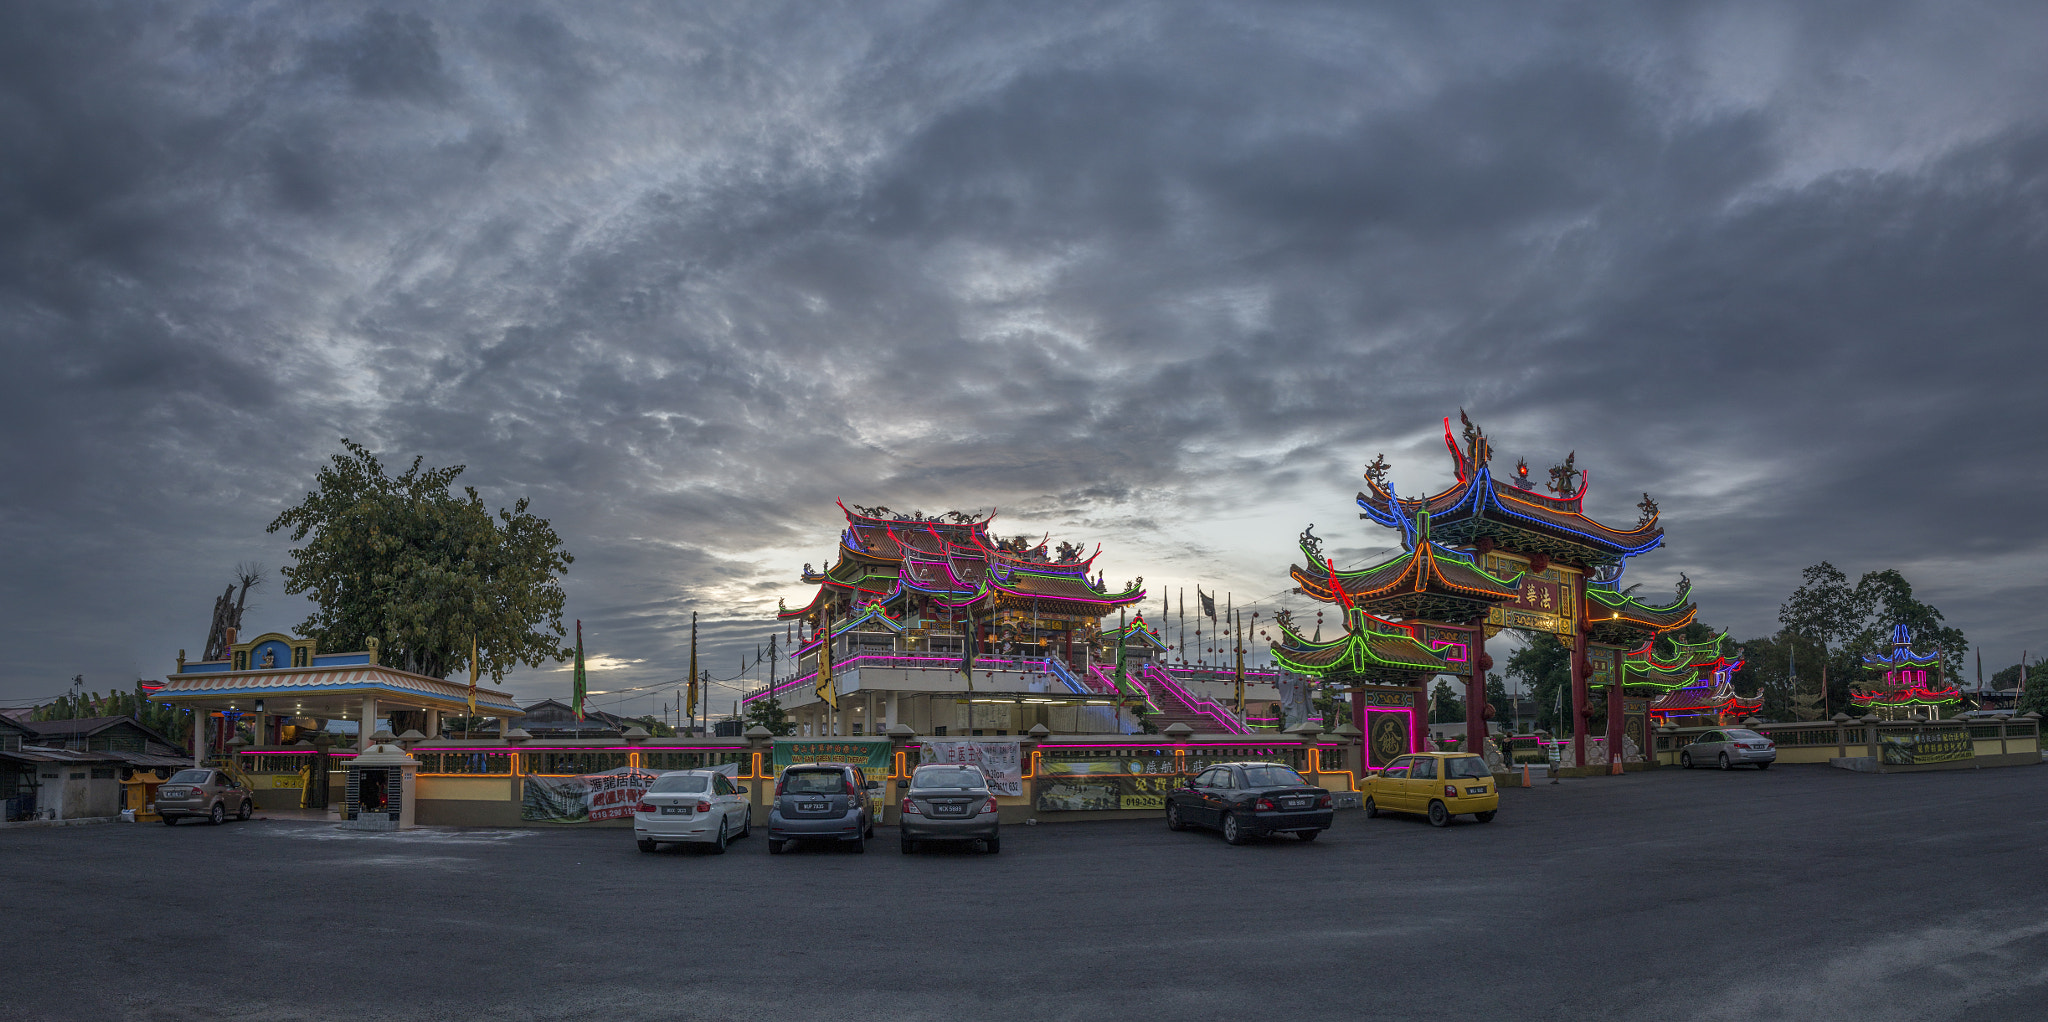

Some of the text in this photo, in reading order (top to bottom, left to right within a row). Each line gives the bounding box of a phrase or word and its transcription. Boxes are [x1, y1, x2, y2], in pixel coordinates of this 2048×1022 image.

[815, 754, 831, 763] GREEN
[847, 755, 869, 765] THERAPY
[592, 810, 608, 820] 018
